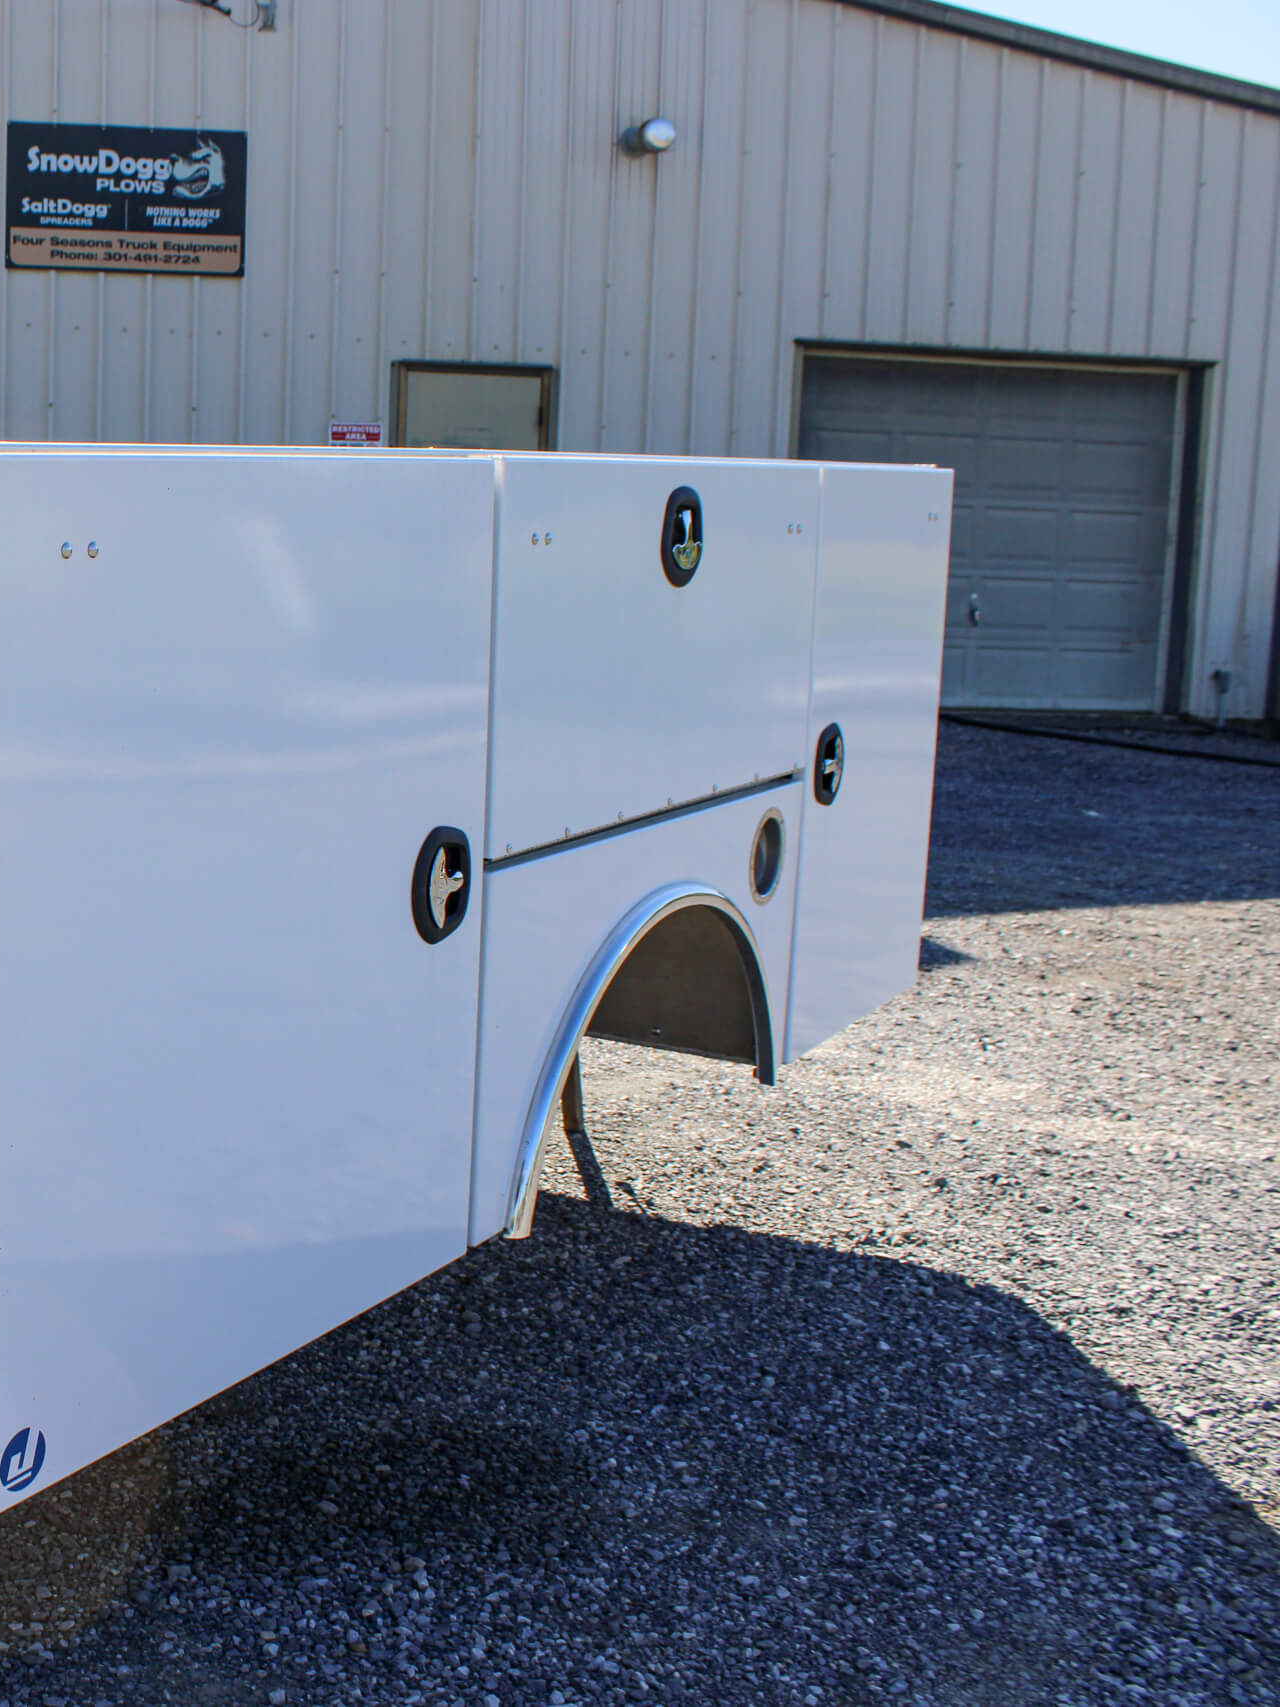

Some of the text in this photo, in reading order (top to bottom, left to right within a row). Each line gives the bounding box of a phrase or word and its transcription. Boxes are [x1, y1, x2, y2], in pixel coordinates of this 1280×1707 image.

[27, 145, 172, 180] SnowDogg
[96, 178, 166, 195] PLOWS
[21, 197, 109, 218] SaltDogg
[145, 206, 221, 219] NOTHING WORKS
[40, 216, 93, 226] SPREADERS
[153, 216, 172, 227] LIKE
[174, 217, 180, 227] A
[13, 234, 238, 254] Four Seasons Truck Equipment
[50, 249, 98, 261] Phone:
